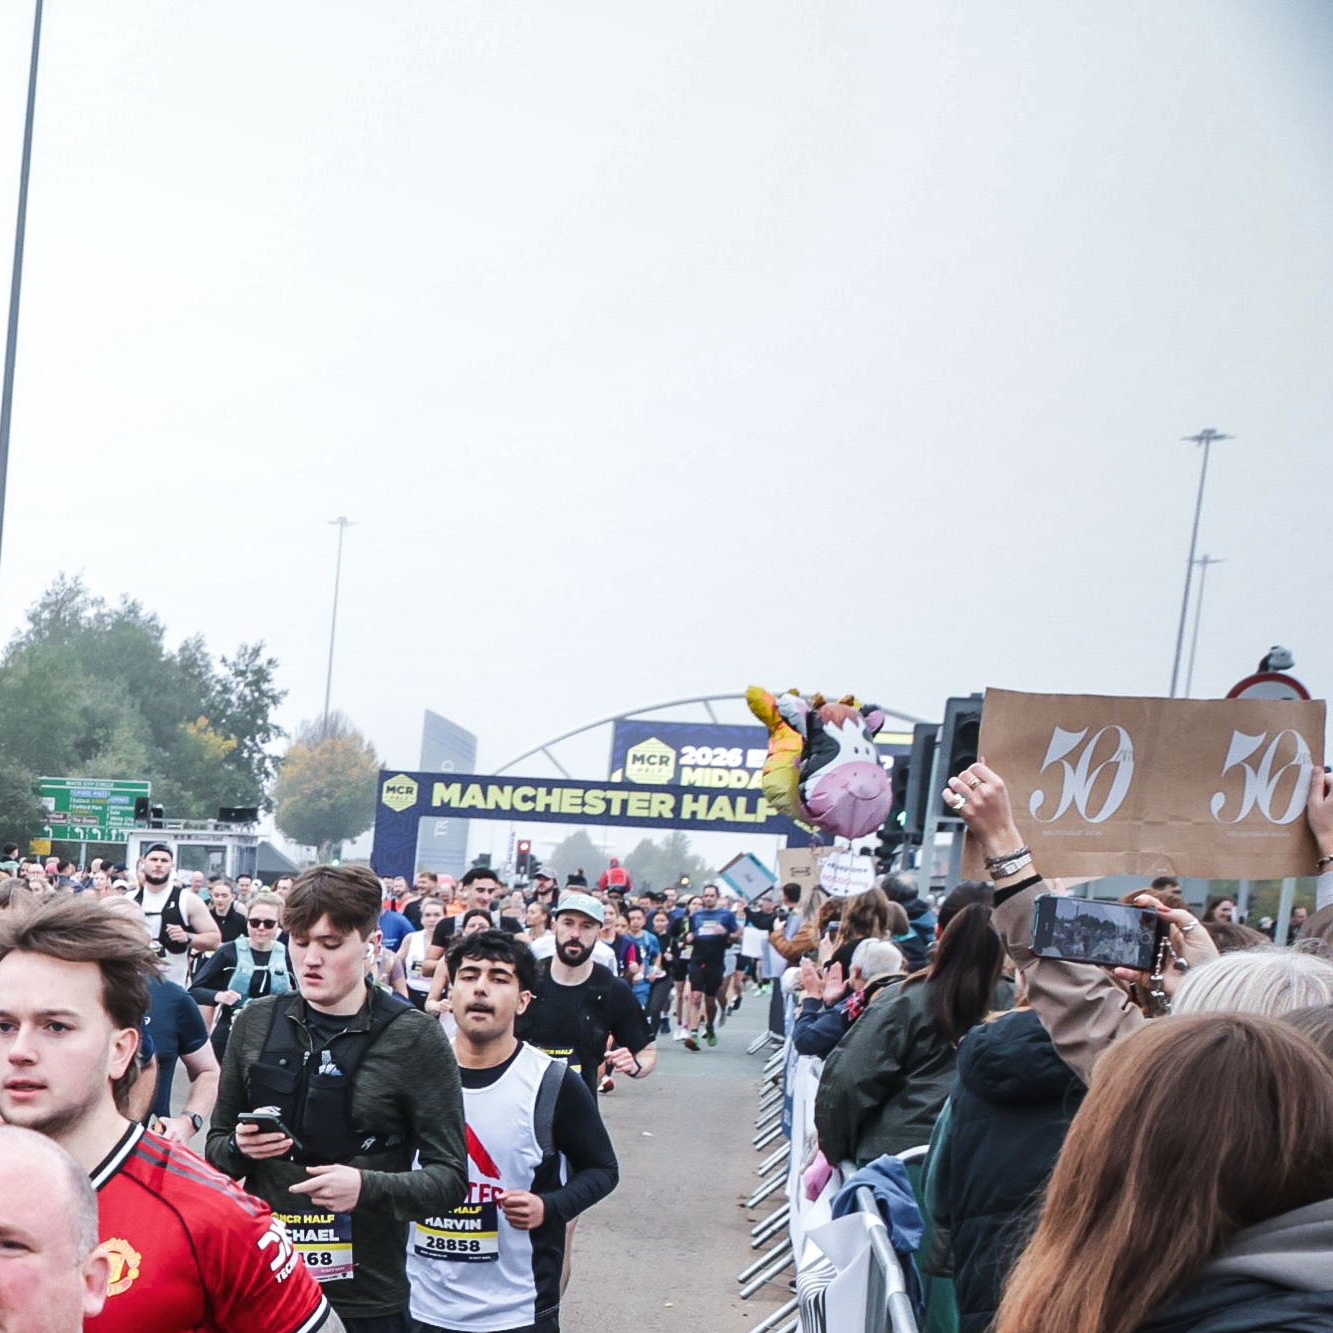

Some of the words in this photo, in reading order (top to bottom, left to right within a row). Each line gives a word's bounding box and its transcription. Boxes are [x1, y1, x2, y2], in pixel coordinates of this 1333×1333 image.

[631, 753, 671, 767] MCR
[680, 746, 744, 766] 2026
[385, 785, 415, 795] MCR
[432, 782, 675, 819] MANCHESTER
[680, 794, 780, 824] HALF
[303, 1214, 336, 1224] HALF
[426, 1236, 481, 1253] 28858
